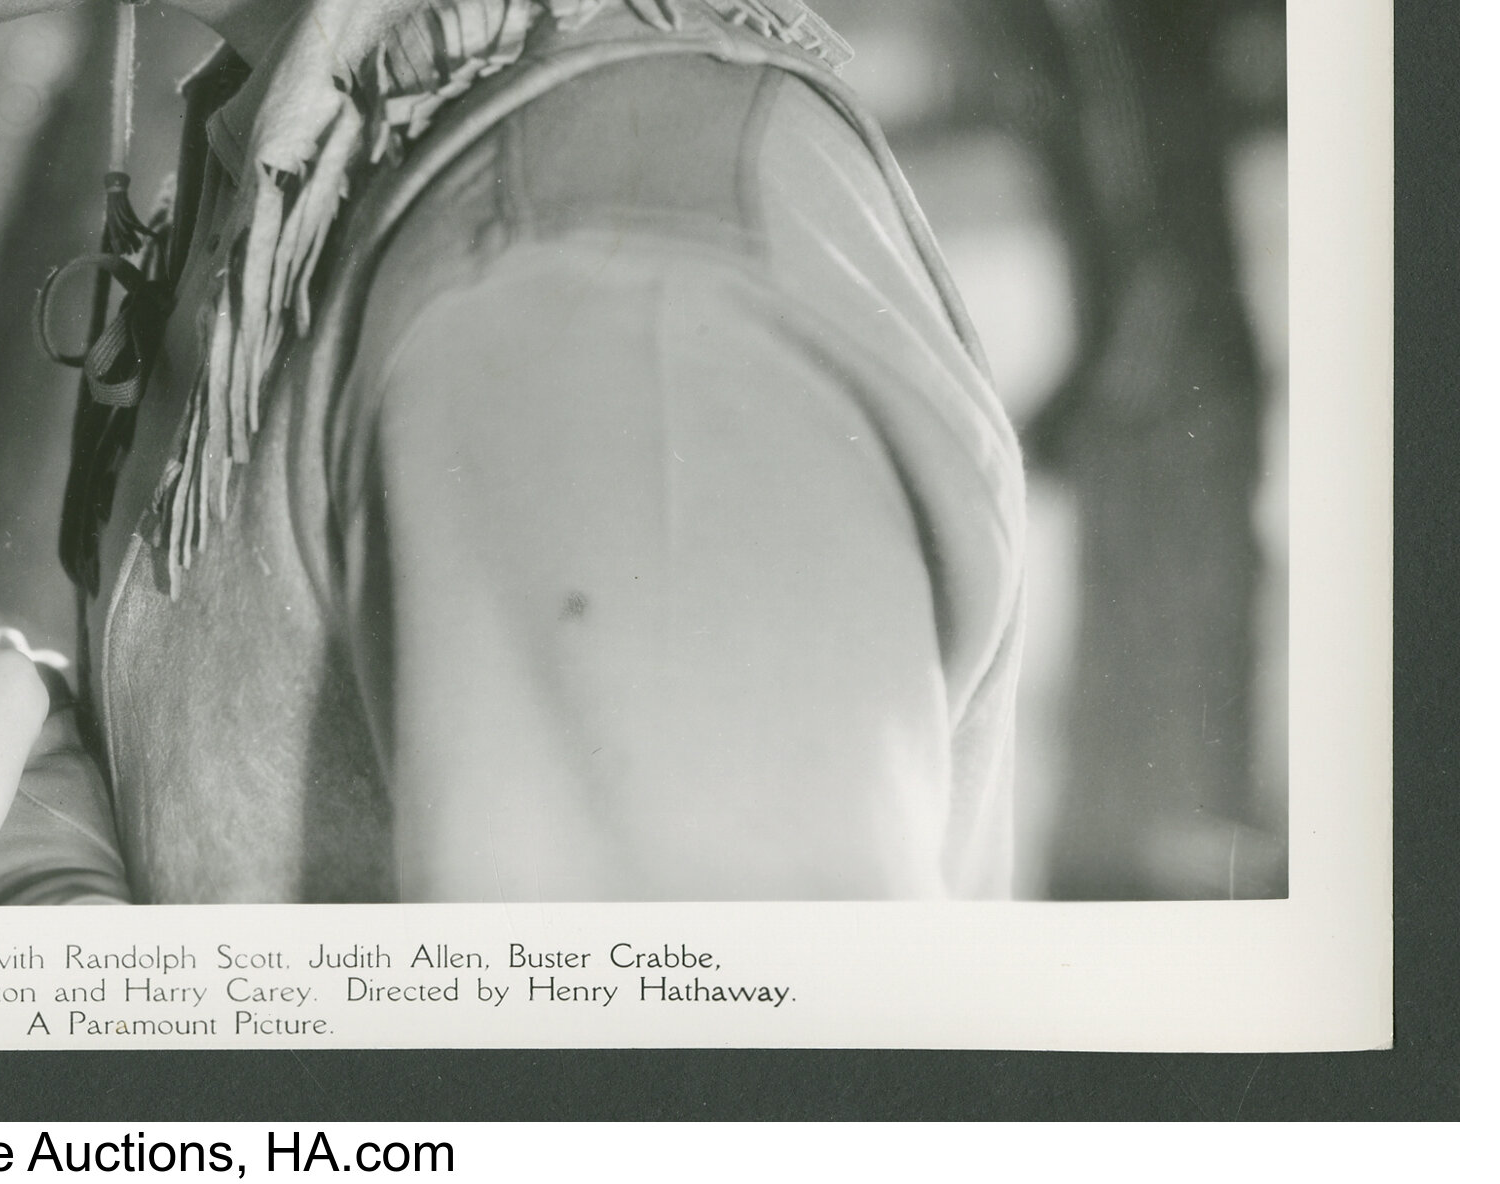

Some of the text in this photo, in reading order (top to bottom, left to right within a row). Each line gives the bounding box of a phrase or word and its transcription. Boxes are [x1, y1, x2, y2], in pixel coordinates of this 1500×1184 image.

[65, 944, 196, 975] Randolph
[308, 943, 391, 969] Judith
[409, 943, 490, 971] Allen,
[508, 942, 592, 969] Buster
[609, 942, 721, 972] Crabbe,
[54, 977, 106, 1003] and
[125, 977, 208, 1008] Harry
[226, 977, 317, 1008] Carey.
[347, 976, 459, 1002] Directed
[477, 977, 510, 1008] by
[528, 976, 619, 1008] Henry
[639, 976, 796, 1008] Hathaway.
[26, 1010, 334, 1036] A Paramount Picture.
